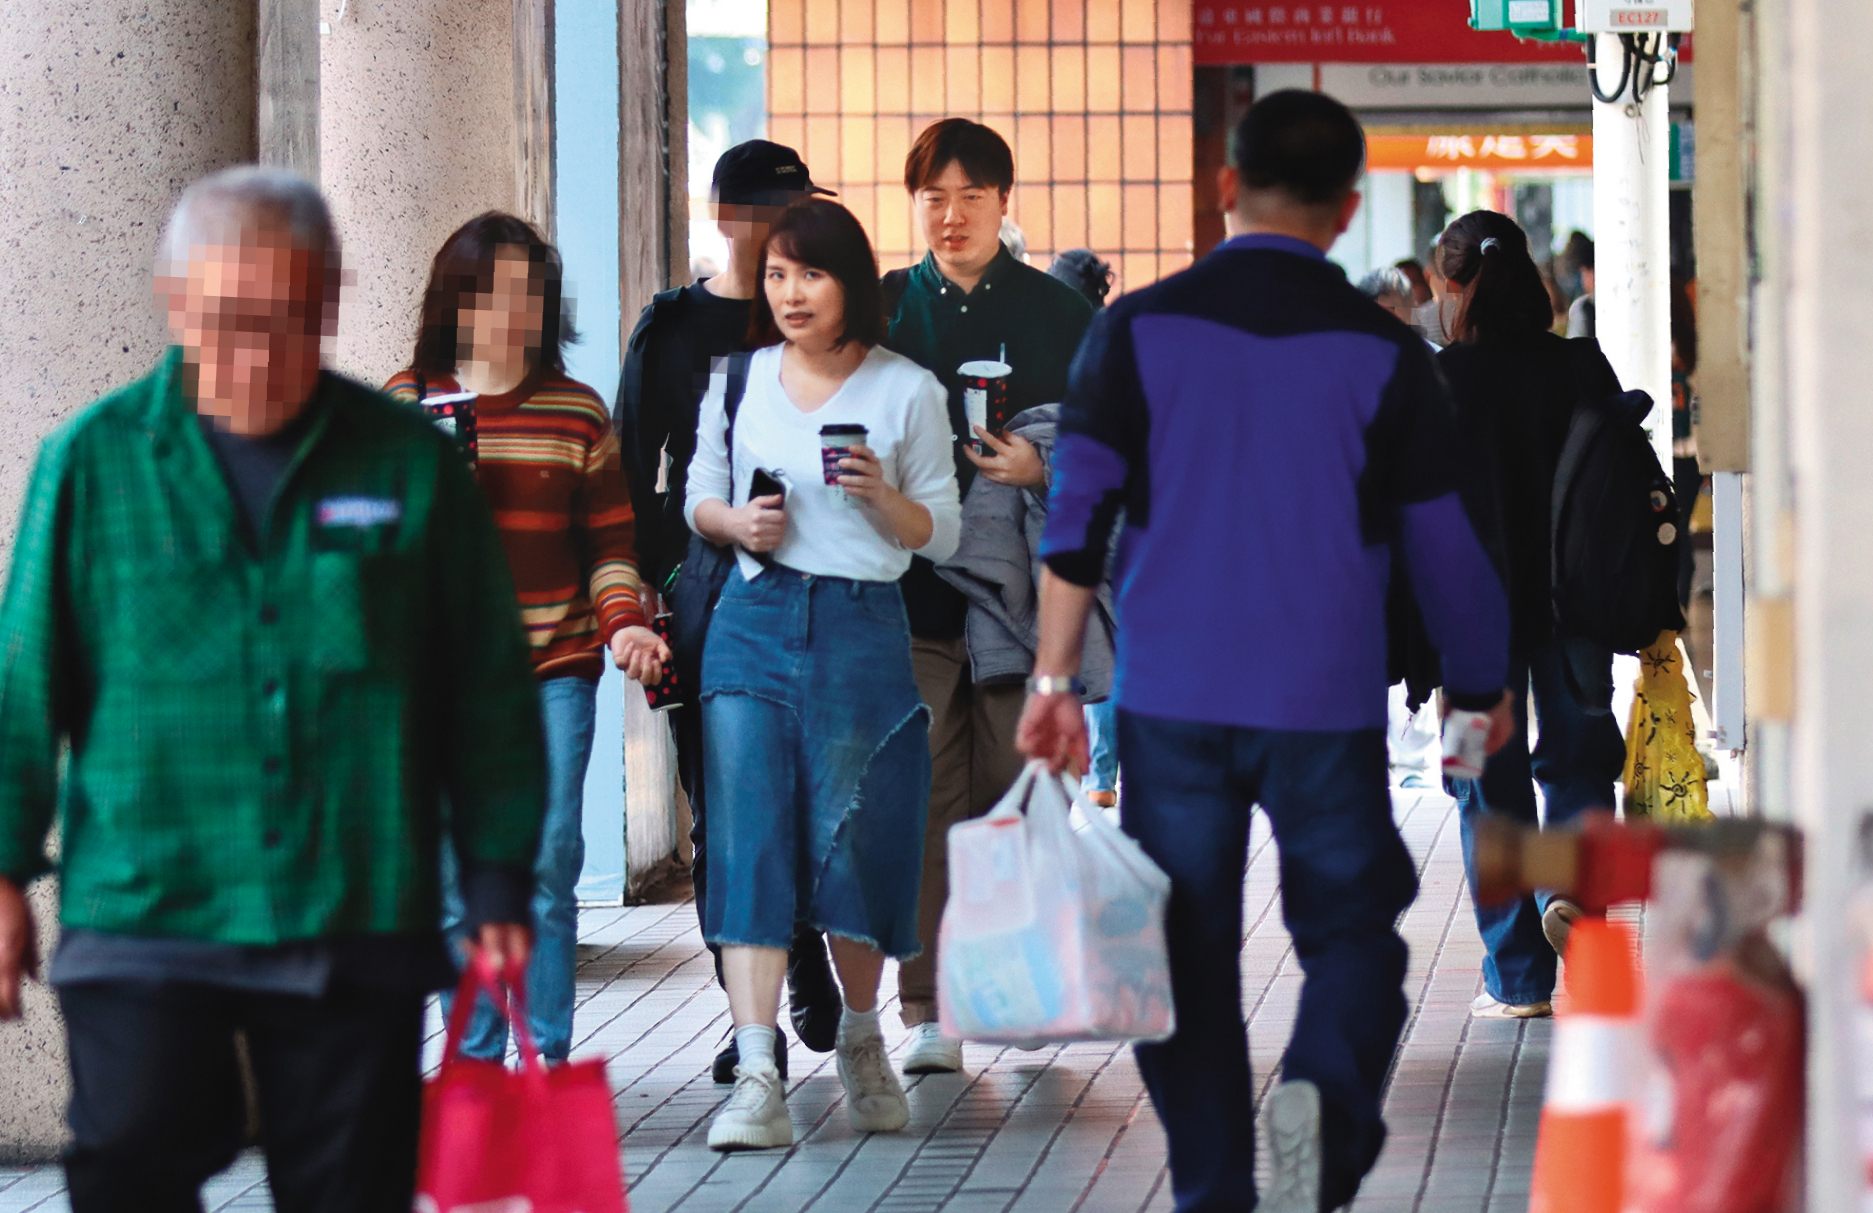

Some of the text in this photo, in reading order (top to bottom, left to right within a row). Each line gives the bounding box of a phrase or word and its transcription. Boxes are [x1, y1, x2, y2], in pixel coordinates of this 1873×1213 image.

[1618, 11, 1660, 24] EC127
[1367, 66, 1410, 87] Our
[1416, 65, 1483, 87] Savior
